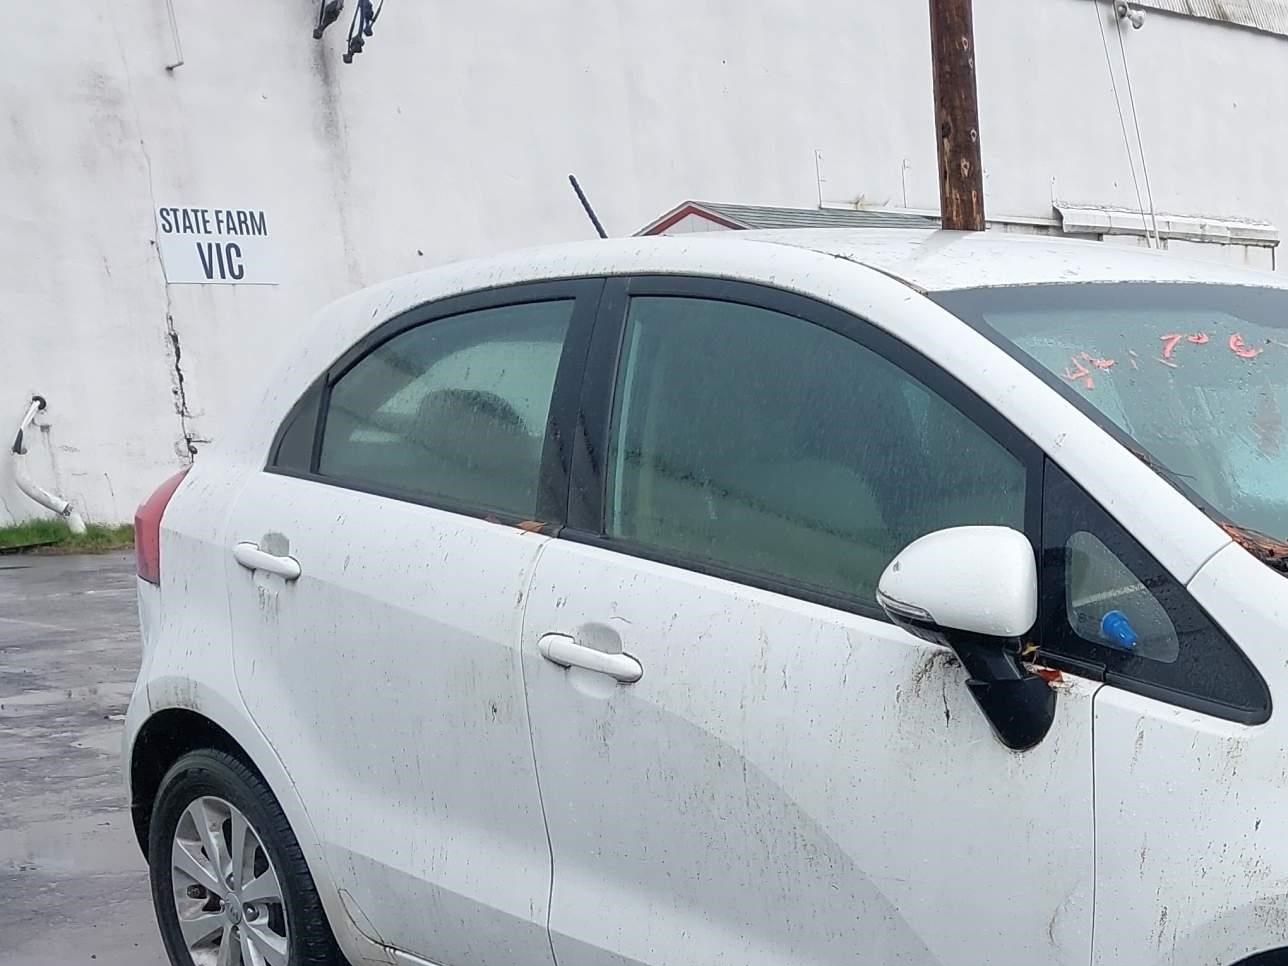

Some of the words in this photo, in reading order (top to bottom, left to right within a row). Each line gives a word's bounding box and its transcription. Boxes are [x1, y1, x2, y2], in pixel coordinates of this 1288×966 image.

[159, 207, 212, 234] STATE
[214, 209, 268, 236] FARM
[196, 242, 244, 280] VIC
